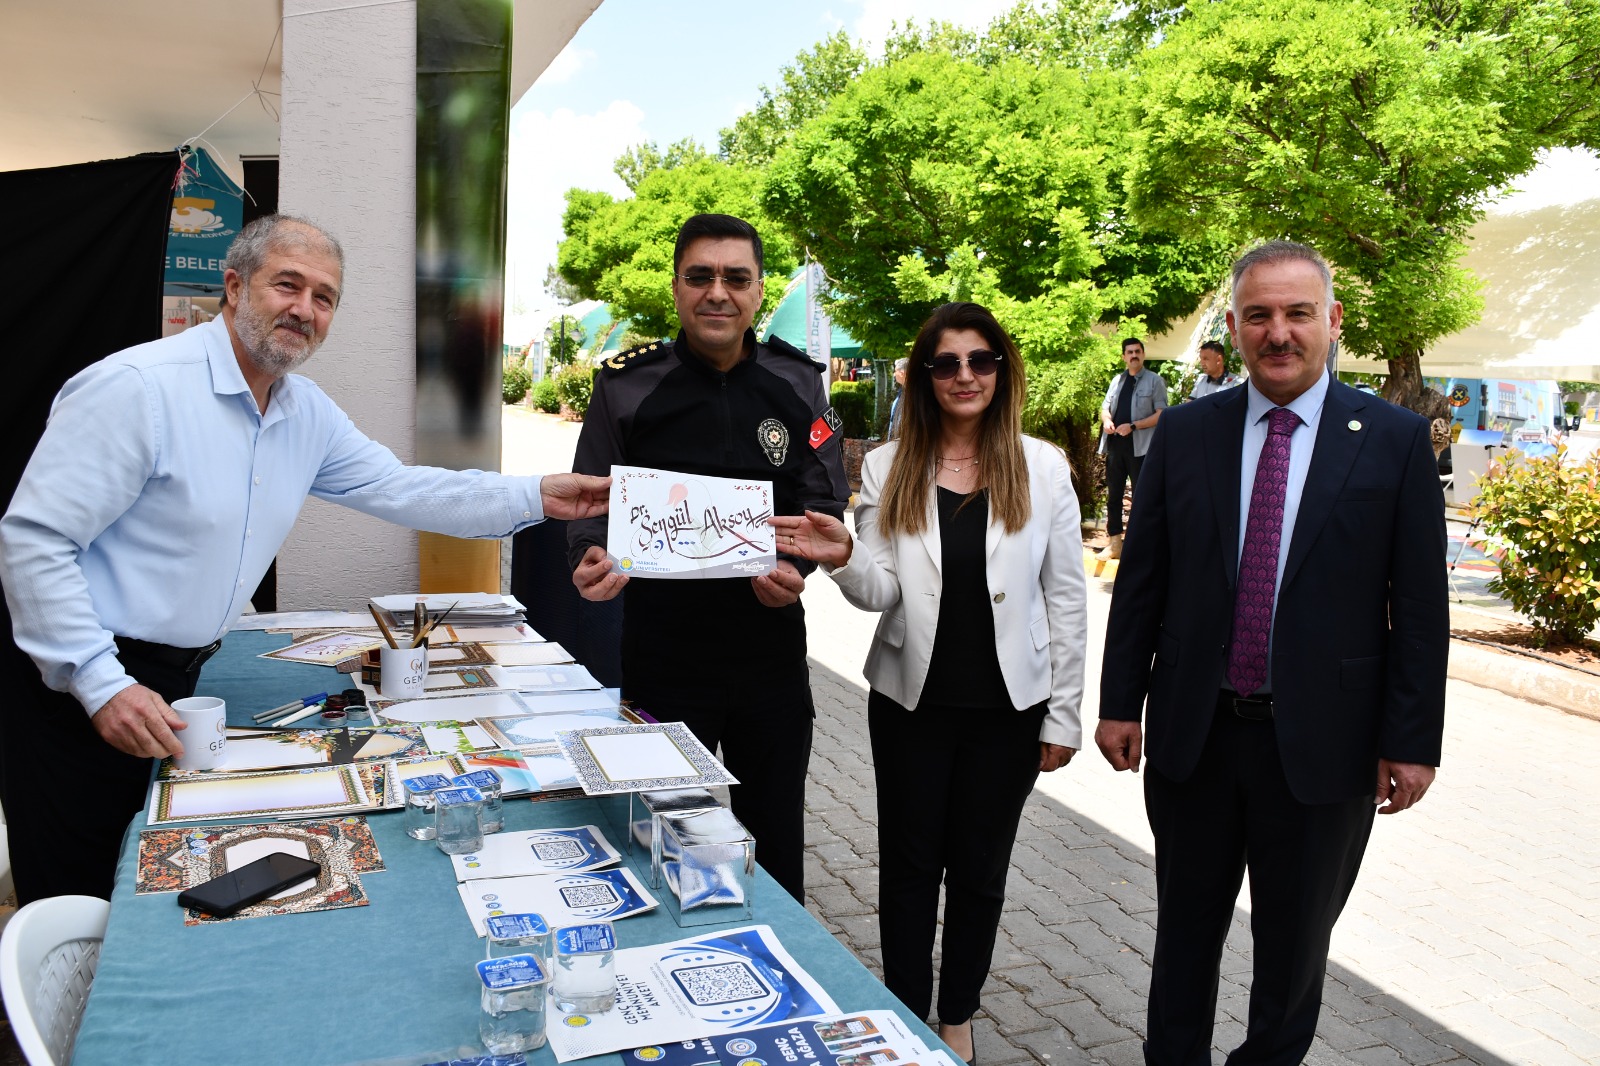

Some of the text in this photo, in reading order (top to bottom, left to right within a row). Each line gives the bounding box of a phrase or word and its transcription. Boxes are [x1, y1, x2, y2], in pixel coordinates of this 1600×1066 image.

[630, 504, 649, 524] Dr.
[637, 500, 772, 554] Şengül Aksoy
[615, 974, 654, 1021] MEMNUNİYET
[632, 981, 661, 1007] ANKETİ
[617, 1005, 639, 1025] GENÇ
[787, 1026, 817, 1059] AĞAZA
